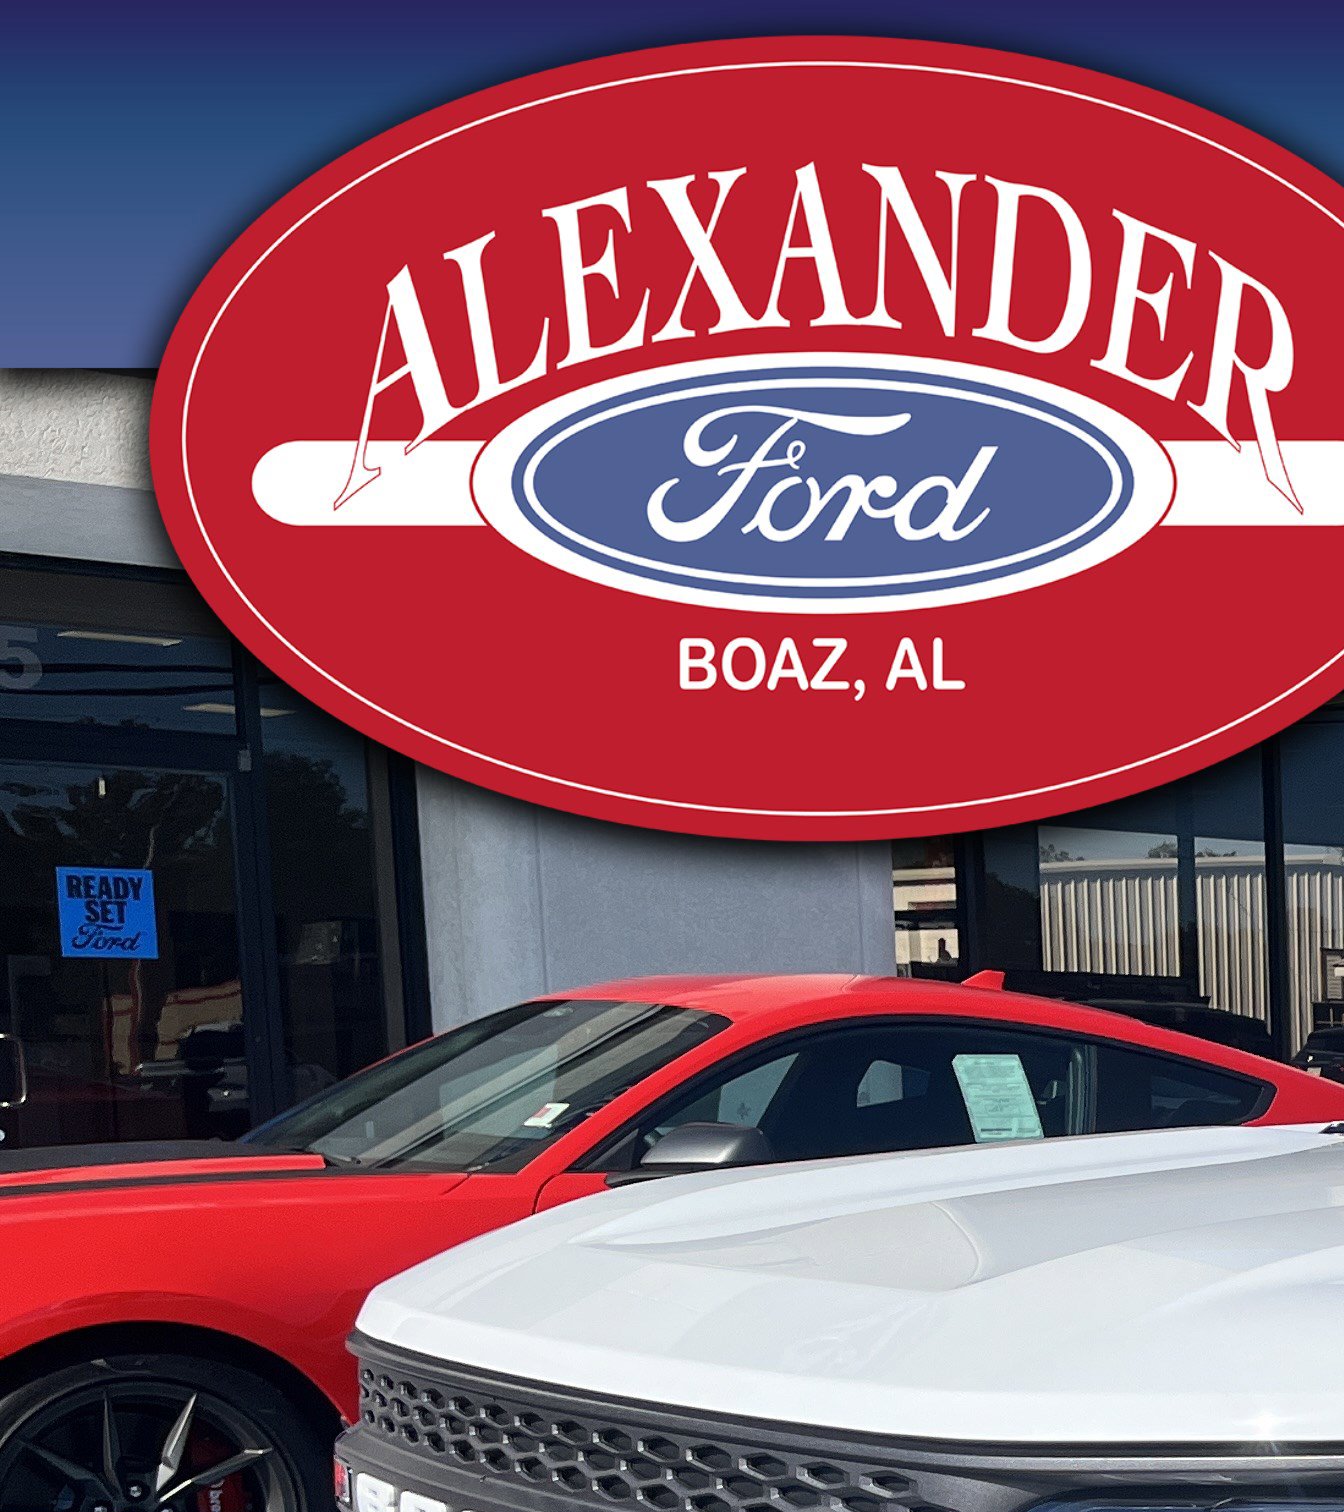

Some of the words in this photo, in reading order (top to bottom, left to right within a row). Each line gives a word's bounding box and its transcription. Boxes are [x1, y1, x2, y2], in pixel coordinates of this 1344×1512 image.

[66, 875, 143, 900] READY
[85, 900, 127, 924] SET
[71, 923, 142, 951] Ford
